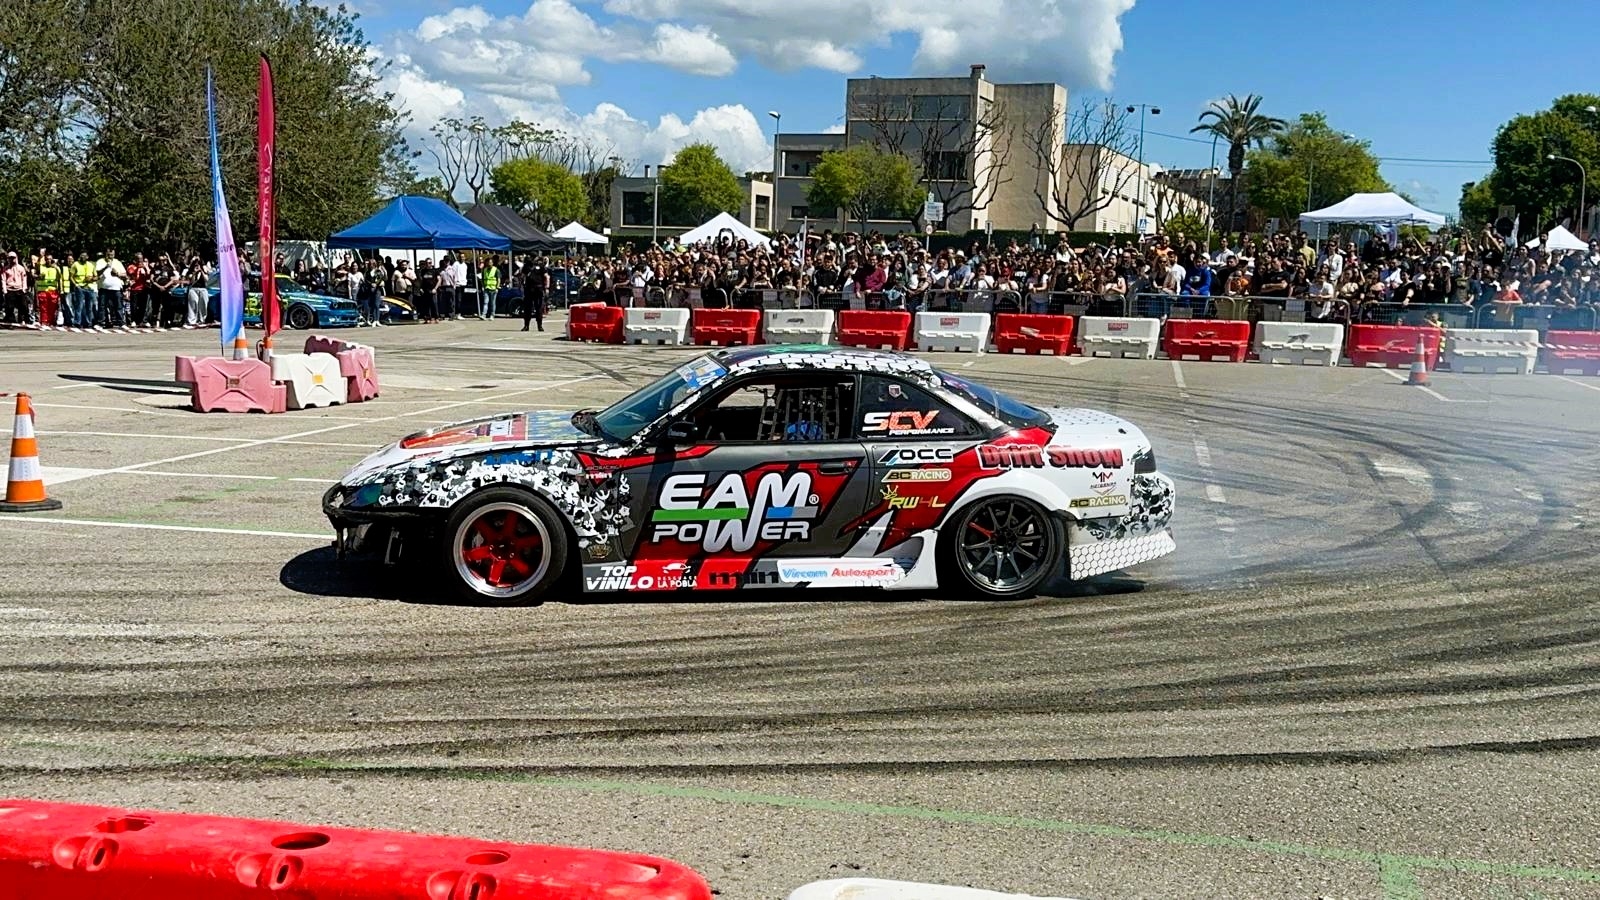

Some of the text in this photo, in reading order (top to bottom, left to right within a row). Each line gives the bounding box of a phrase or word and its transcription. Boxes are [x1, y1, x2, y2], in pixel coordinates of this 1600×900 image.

[862, 410, 940, 431] SCV
[888, 427, 955, 436] PERFORMANCE
[979, 444, 1124, 469] Drift Show
[659, 472, 812, 510] EAM
[652, 519, 810, 553] POWER
[600, 565, 637, 577] TOP
[831, 567, 896, 580] Autosport
[657, 579, 698, 589] LA POBLA
